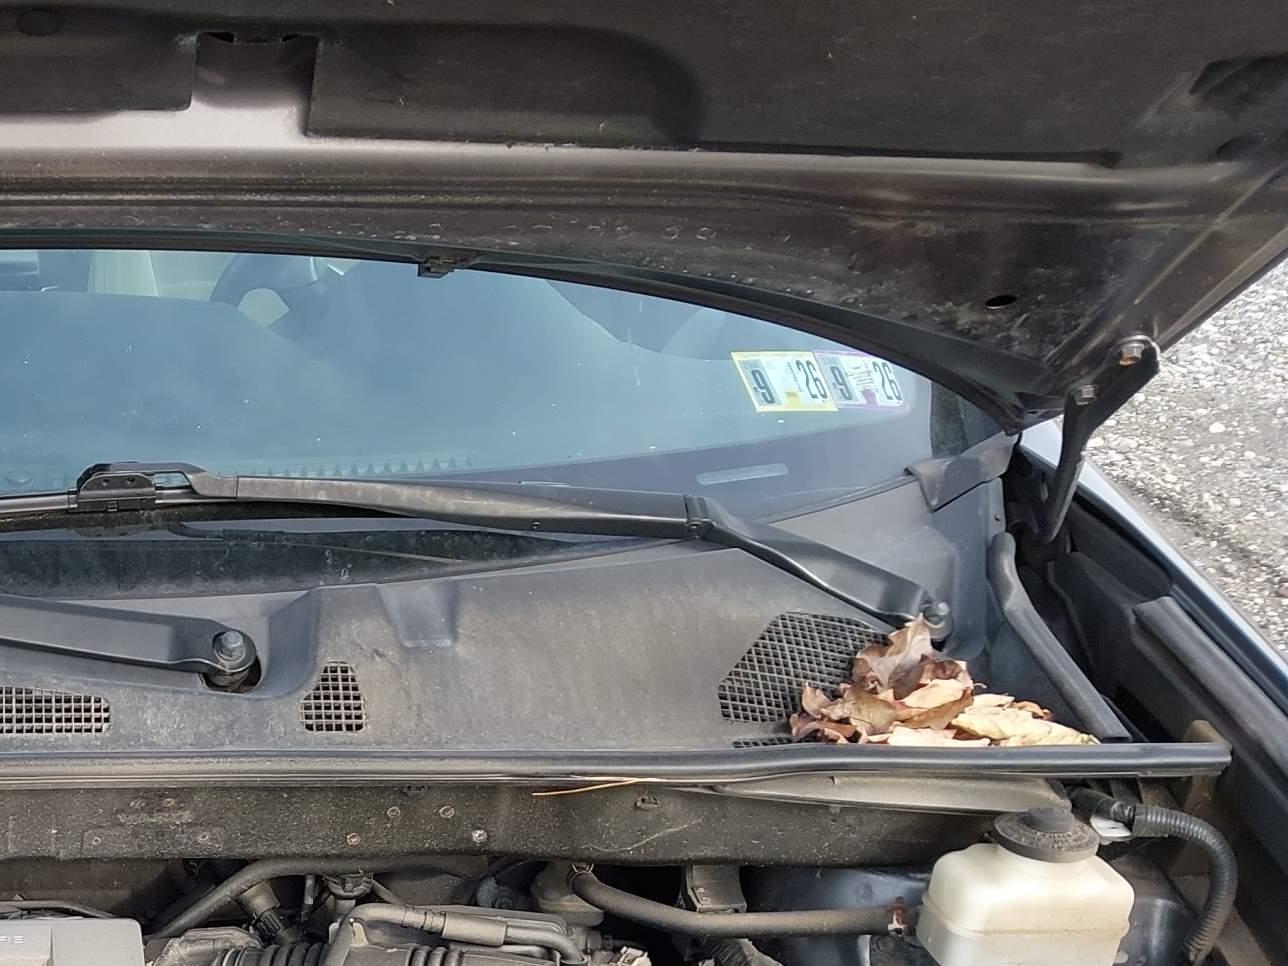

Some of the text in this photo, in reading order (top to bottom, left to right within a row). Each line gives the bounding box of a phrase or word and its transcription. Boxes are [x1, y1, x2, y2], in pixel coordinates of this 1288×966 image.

[750, 369, 777, 405] 9
[795, 360, 828, 400] 26
[830, 365, 853, 401] 9
[871, 361, 903, 401] 26
